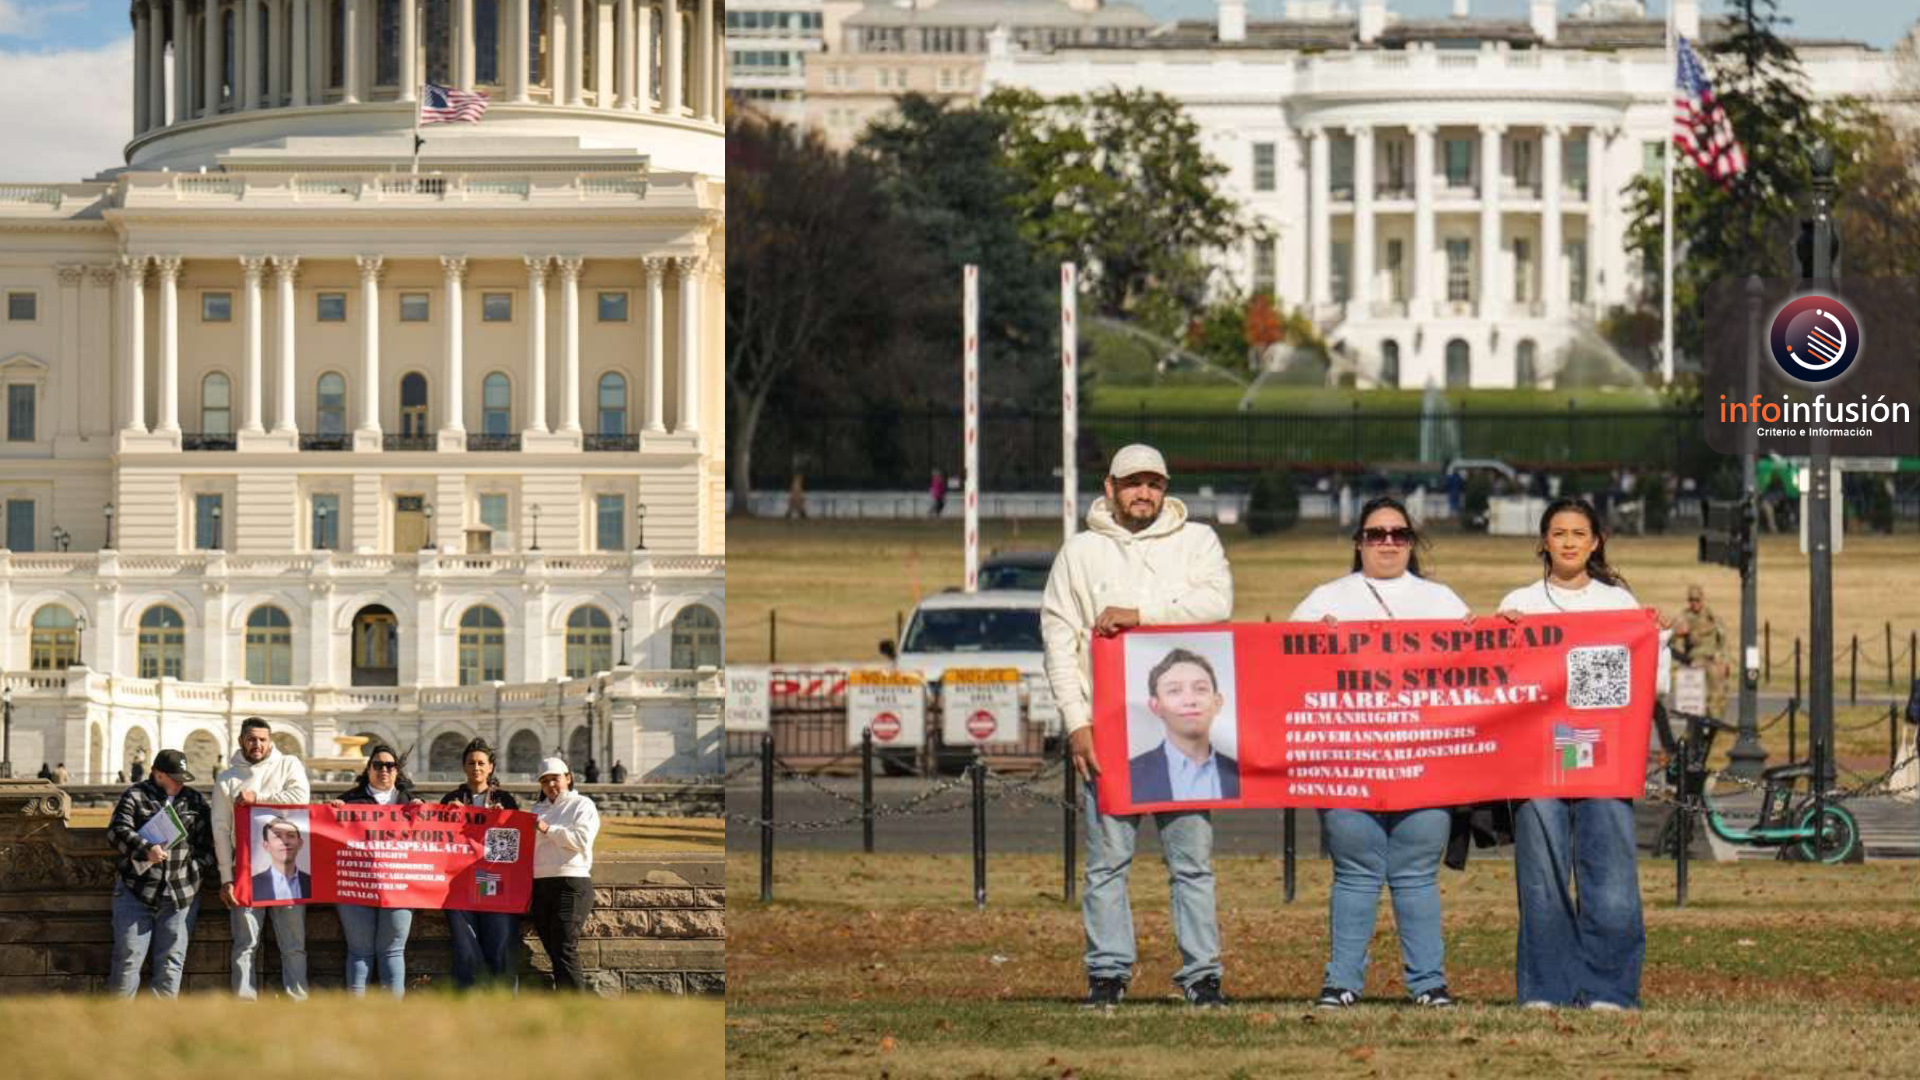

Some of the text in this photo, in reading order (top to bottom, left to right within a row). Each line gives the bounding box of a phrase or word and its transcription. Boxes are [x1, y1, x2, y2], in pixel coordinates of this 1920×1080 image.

[1282, 625, 1563, 655] HELP US SPREAD
[1337, 665, 1514, 690] HIS STORY
[1304, 684, 1548, 710] SHARE.SPEAK.ACT.
[1285, 710, 1420, 725] #HUMANRIGHTS
[1285, 726, 1476, 744] #LOVEHASNOBORDERS
[1285, 741, 1497, 762] #WHEREISCARLOSEMILIO
[1288, 764, 1424, 779] #DONALDTRUMP
[1288, 782, 1370, 798] #SINALOA
[336, 810, 487, 825] HELP US SPREAD
[364, 829, 456, 843] HIS STORY
[337, 879, 408, 891] #DONALDTRUMP
[337, 890, 379, 900] #SINALOA
